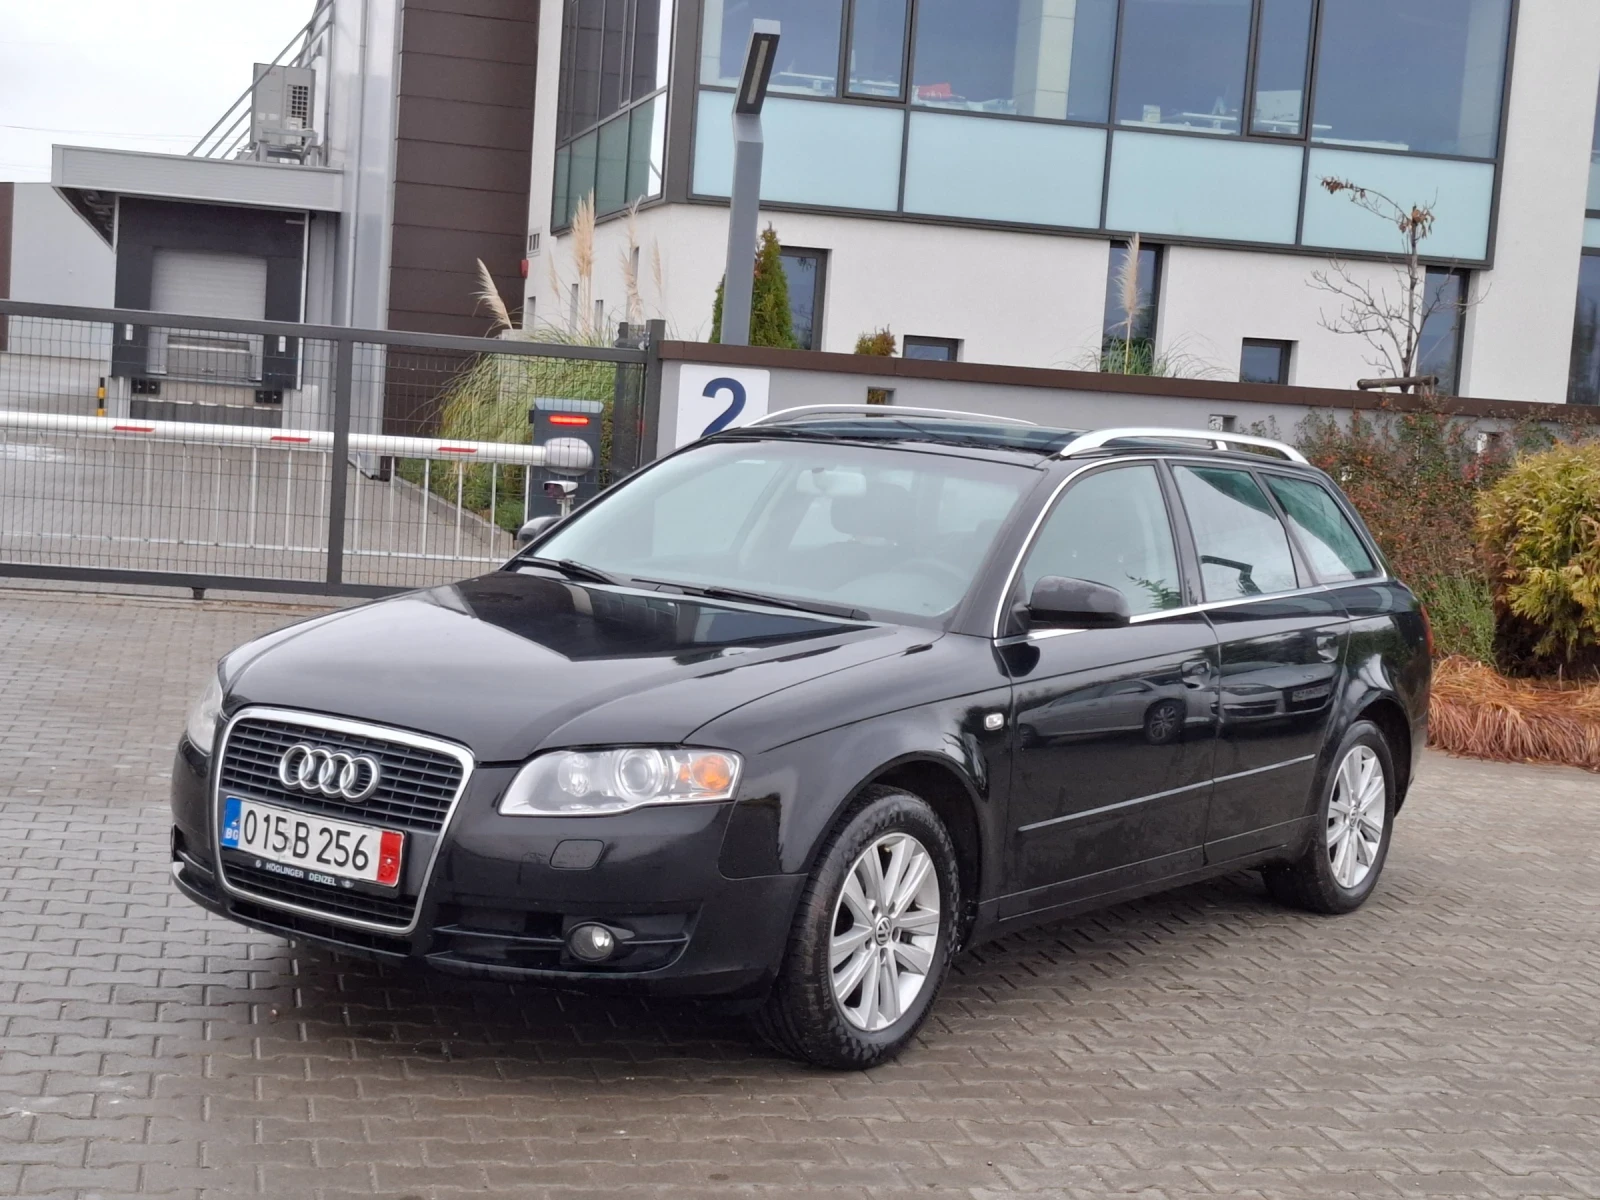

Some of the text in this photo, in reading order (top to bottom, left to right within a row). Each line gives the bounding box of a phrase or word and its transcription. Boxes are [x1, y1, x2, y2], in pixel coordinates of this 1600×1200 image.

[701, 377, 747, 438] 2
[225, 827, 239, 840] BG
[265, 862, 337, 886] HÖGLINGER DENZEL
